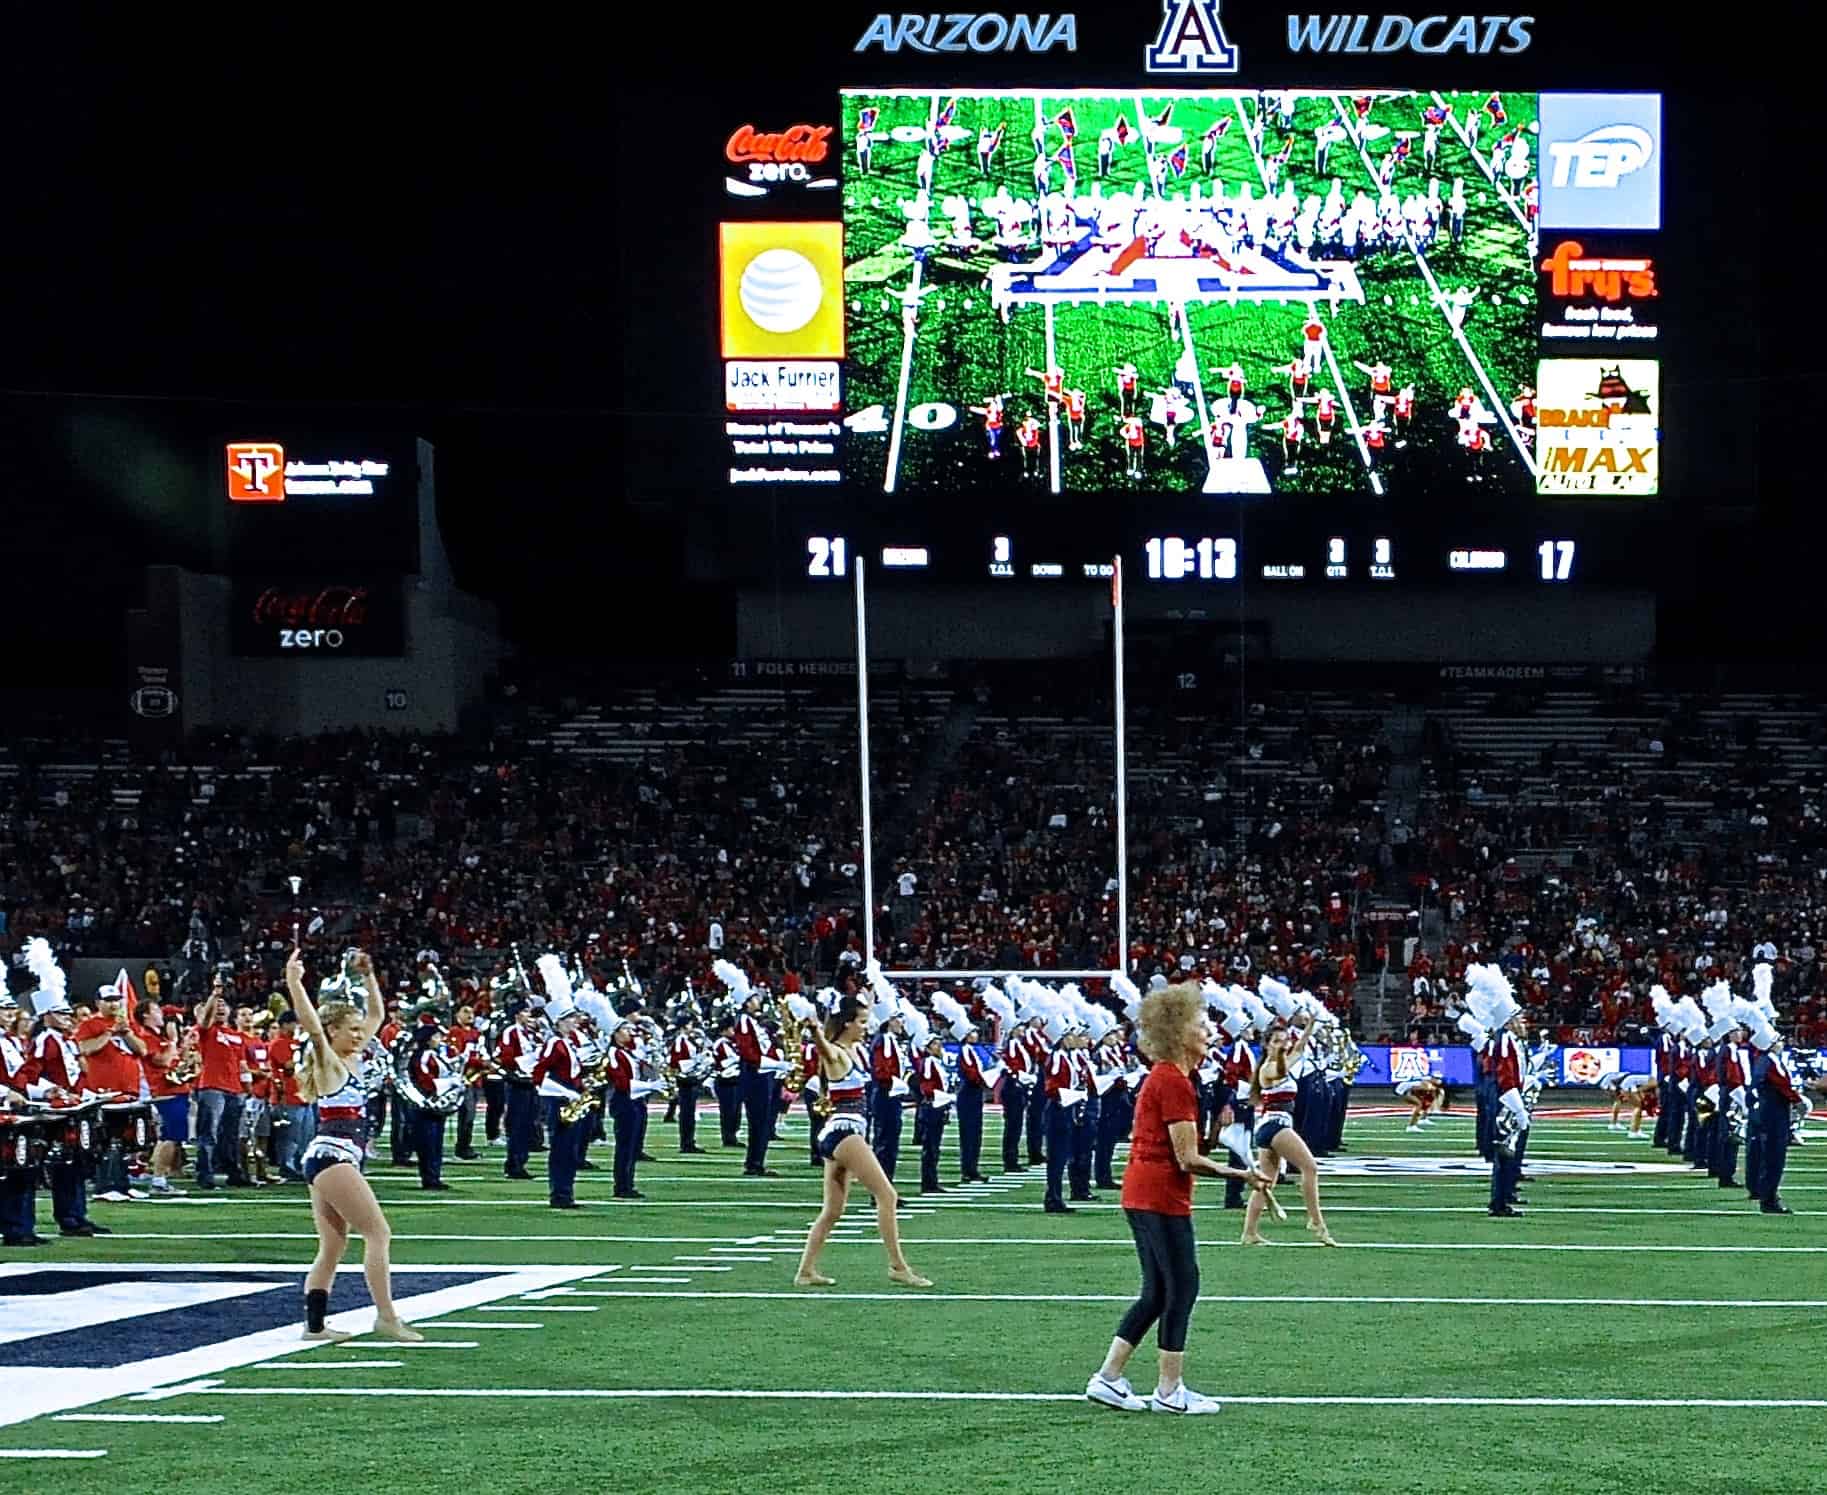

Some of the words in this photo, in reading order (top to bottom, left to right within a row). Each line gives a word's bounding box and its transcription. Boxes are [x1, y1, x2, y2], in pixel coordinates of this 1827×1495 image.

[853, 14, 1077, 52] ARIZONA
[1286, 14, 1535, 53] WILDCATS
[1549, 141, 1643, 188] TEP
[731, 367, 769, 387] Jack
[778, 366, 834, 387] Furrier
[808, 537, 845, 576] 21
[1538, 540, 1575, 579] 17
[279, 629, 345, 647] zero
[1176, 672, 1197, 688] 12
[386, 692, 406, 708] 10
